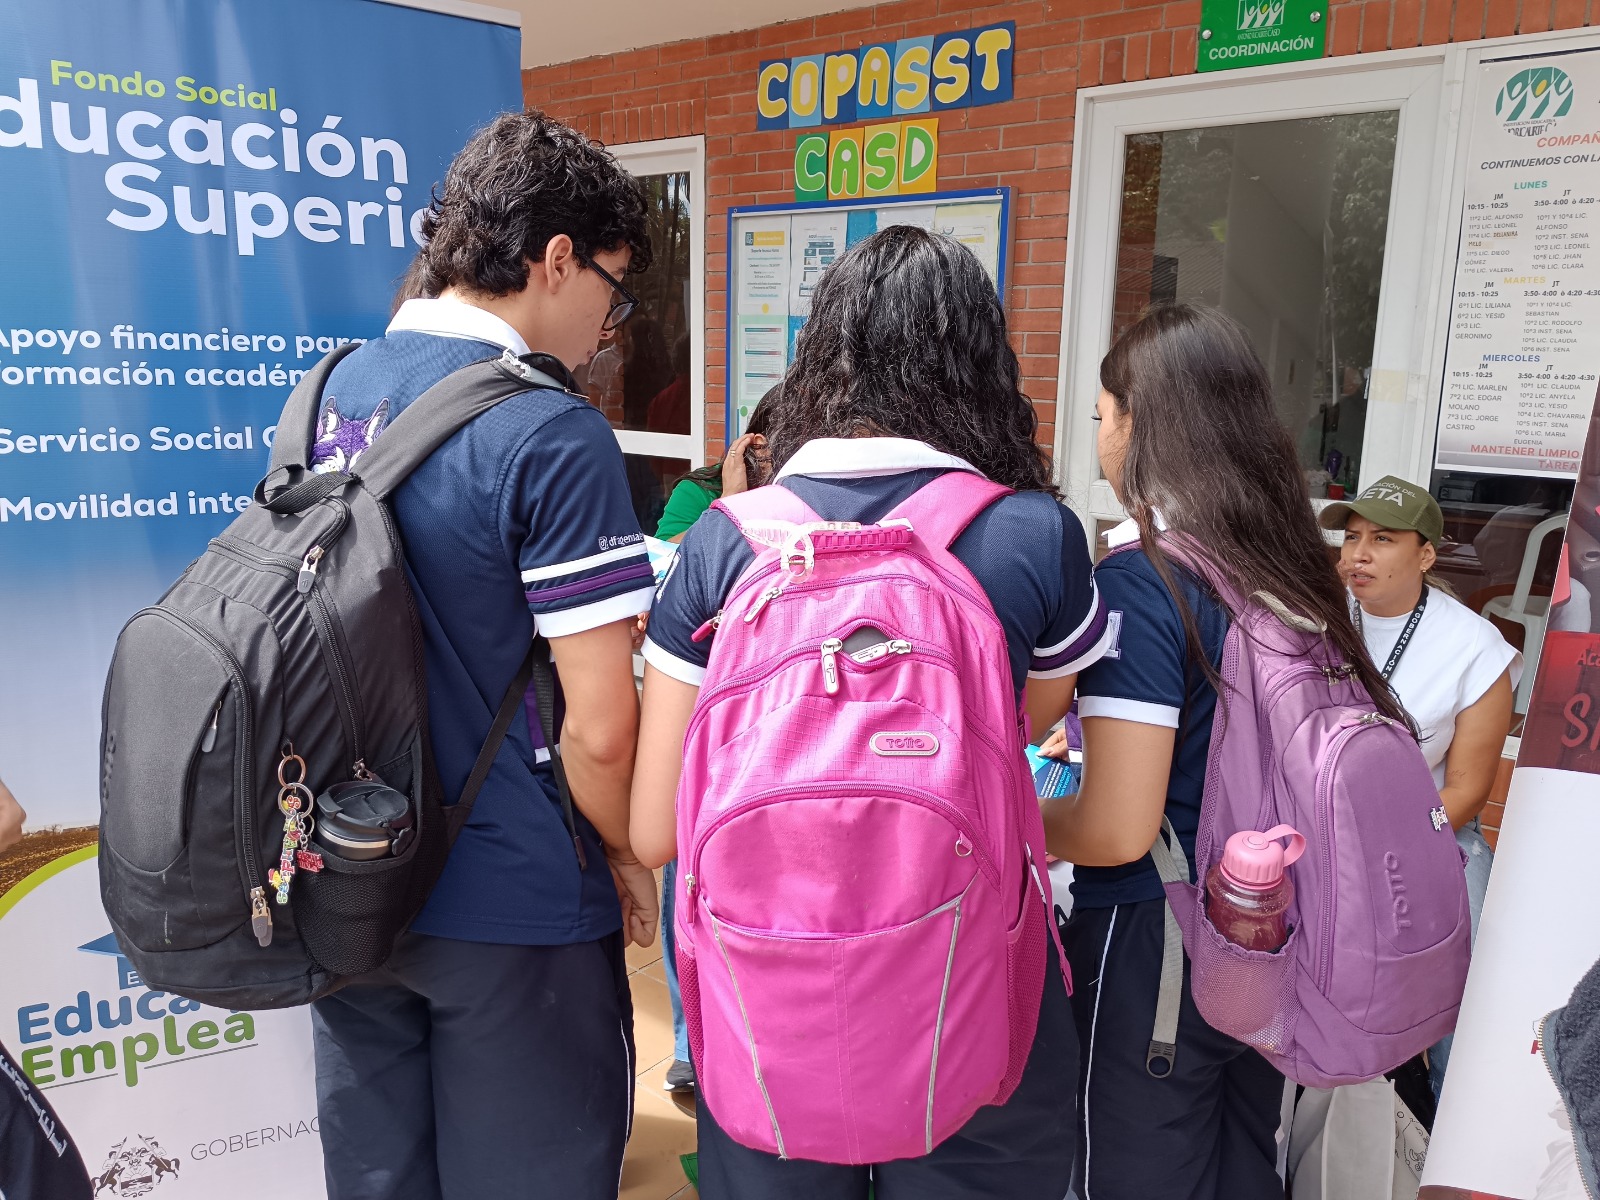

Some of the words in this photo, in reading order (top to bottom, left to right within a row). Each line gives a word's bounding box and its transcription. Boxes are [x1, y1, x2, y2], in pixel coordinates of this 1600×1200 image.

[1209, 35, 1314, 60] COORDINACIÓN
[51, 60, 166, 98] Fondo
[176, 76, 277, 112] Social
[758, 29, 1011, 119] COPASST
[795, 126, 934, 192] CASD
[1481, 157, 1561, 169] CONTINUEMOS
[1564, 155, 1589, 164] CON
[1514, 181, 1548, 189] LUNES
[111, 325, 286, 352] financiero
[1483, 354, 1541, 363] MIERCOLES
[0, 428, 140, 453] Servicio
[151, 426, 252, 451] Social
[1471, 444, 1535, 456] MANTENER
[1538, 448, 1580, 458] LIMPIO
[1538, 460, 1578, 470] TAREA
[1402, 488, 1416, 498] DEL
[0, 494, 178, 522] Movilidad
[1385, 612, 1421, 672] GOBERNACIÓN
[21, 1012, 256, 1088] Emplea
